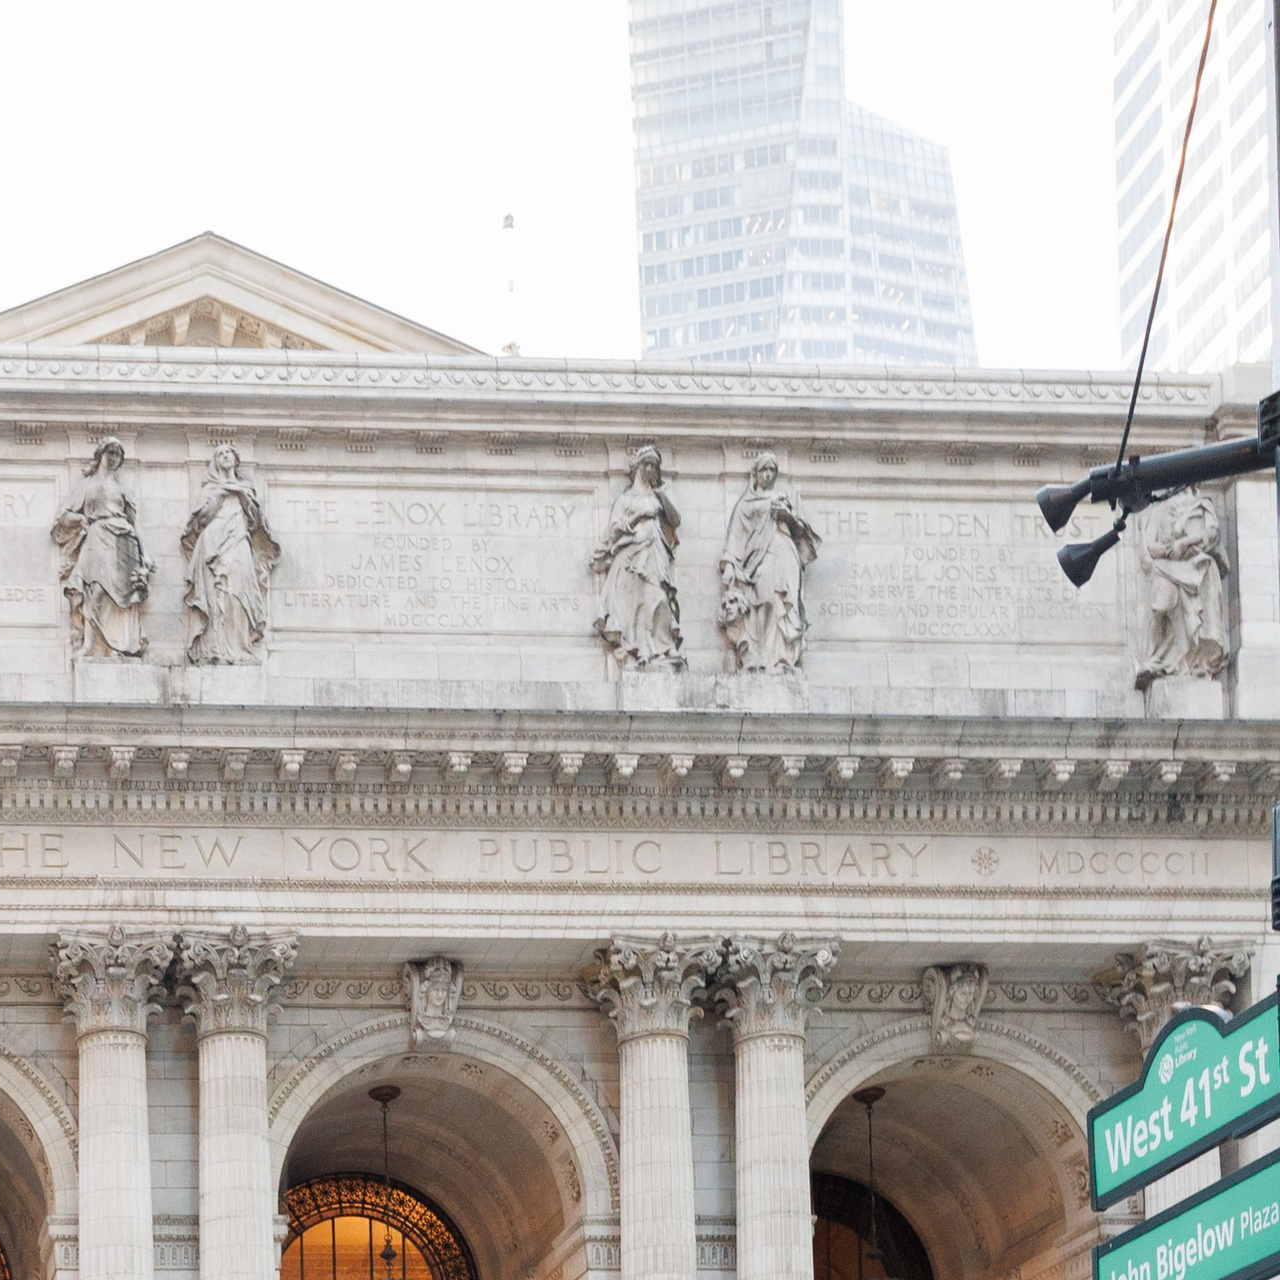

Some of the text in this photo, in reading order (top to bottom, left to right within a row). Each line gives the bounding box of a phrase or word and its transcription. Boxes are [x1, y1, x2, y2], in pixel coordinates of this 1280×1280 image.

[286, 500, 577, 528] THE LENOX LIBRARY
[819, 510, 870, 536] THE
[895, 511, 990, 538] TILDEN
[373, 536, 490, 552] FOUNDED BY
[904, 546, 1017, 563] FOUNDED BY
[350, 553, 515, 574] JAMES LENOX
[849, 563, 1065, 584] SAMUEL JONES TILDE
[324, 574, 540, 593] DEDICATED TO HISTORY
[837, 584, 861, 599] TO
[870, 584, 915, 600] SERVE
[926, 585, 958, 600] THE
[965, 585, 1053, 602] INTERESTS
[282, 592, 580, 612] LITERATURE AND THE FINE ARTS
[819, 602, 1107, 621] SCIENCE AND POPULAR EDUCATION
[384, 612, 484, 628] MDCCCLXX
[111, 833, 244, 870] NEW
[291, 835, 435, 873] YORK
[477, 837, 663, 875] PUBLIC
[713, 840, 930, 877] LIBRARY
[1037, 849, 1213, 876] MDCCCCII
[1175, 1047, 1197, 1068] Library
[1105, 1035, 1270, 1174] West 41st St
[1240, 1202, 1279, 1241] Plaza
